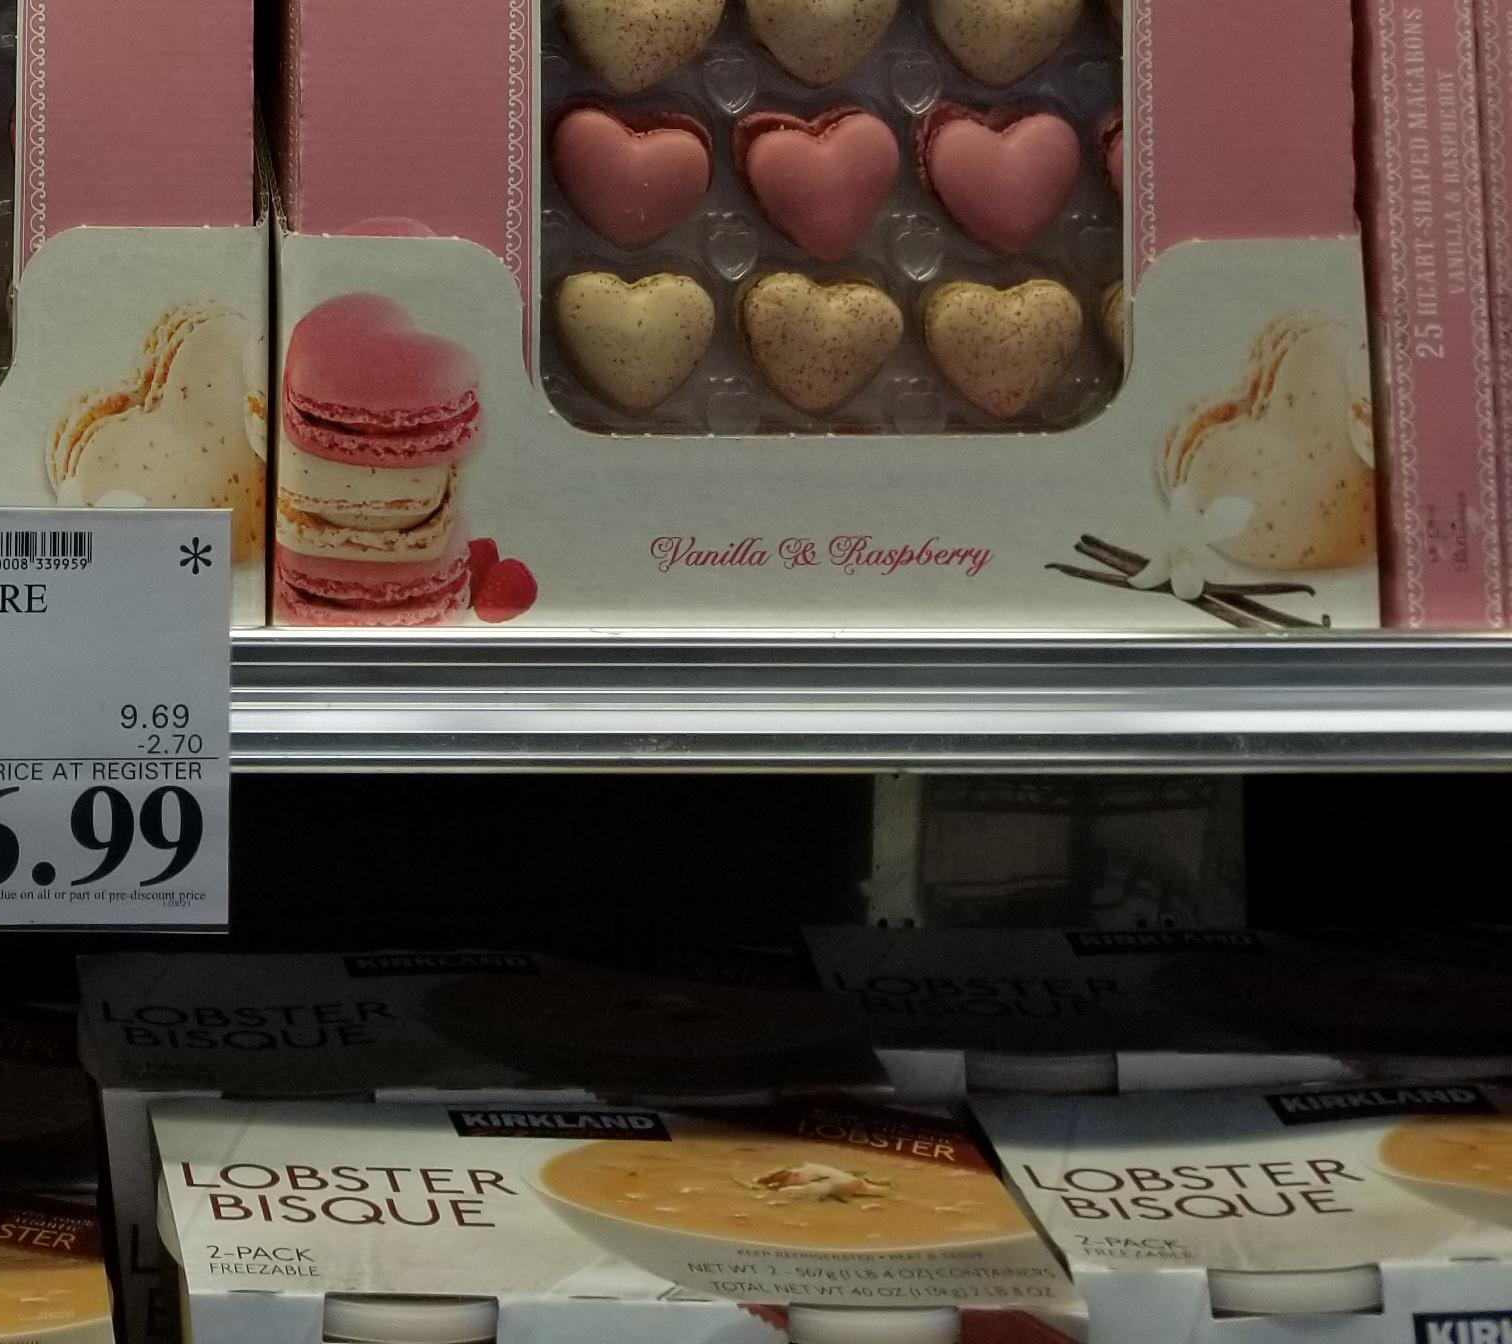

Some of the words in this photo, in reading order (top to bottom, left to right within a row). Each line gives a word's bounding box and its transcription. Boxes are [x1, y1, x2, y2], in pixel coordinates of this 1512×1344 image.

[1403, 7, 1429, 130] MACARONS
[1414, 323, 1445, 359] 25
[35, 558, 88, 571] 339959
[650, 535, 772, 574] Vanilla
[778, 537, 821, 571] &
[829, 535, 993, 577] Raspberry
[120, 703, 190, 730] 9.69
[136, 733, 204, 755] -2.70
[51, 761, 85, 782] AT
[92, 761, 204, 782] REGISTER
[20, 891, 35, 901] on
[37, 889, 51, 901] all
[54, 891, 66, 901] or
[70, 890, 90, 903] part
[94, 889, 107, 901] of
[109, 889, 177, 903] pre-discount
[179, 890, 207, 903] price
[101, 1001, 393, 1027] LOBSTER
[124, 1025, 378, 1050] BISQUE
[1278, 1087, 1480, 1113] KIRKLAND
[461, 1111, 655, 1132] KIRKLAND
[180, 1161, 518, 1196] LOBSTER
[1023, 1158, 1365, 1194] LOBSTER
[209, 1193, 496, 1228] BISQUE
[1060, 1189, 1353, 1221] BISQUE
[206, 1244, 314, 1263] 2-PACK
[209, 1263, 321, 1278] FREEZABLE
[687, 1262, 723, 1274] NET
[728, 1263, 758, 1274] WT
[709, 1280, 768, 1293] TOTAL
[773, 1283, 810, 1295] NET
